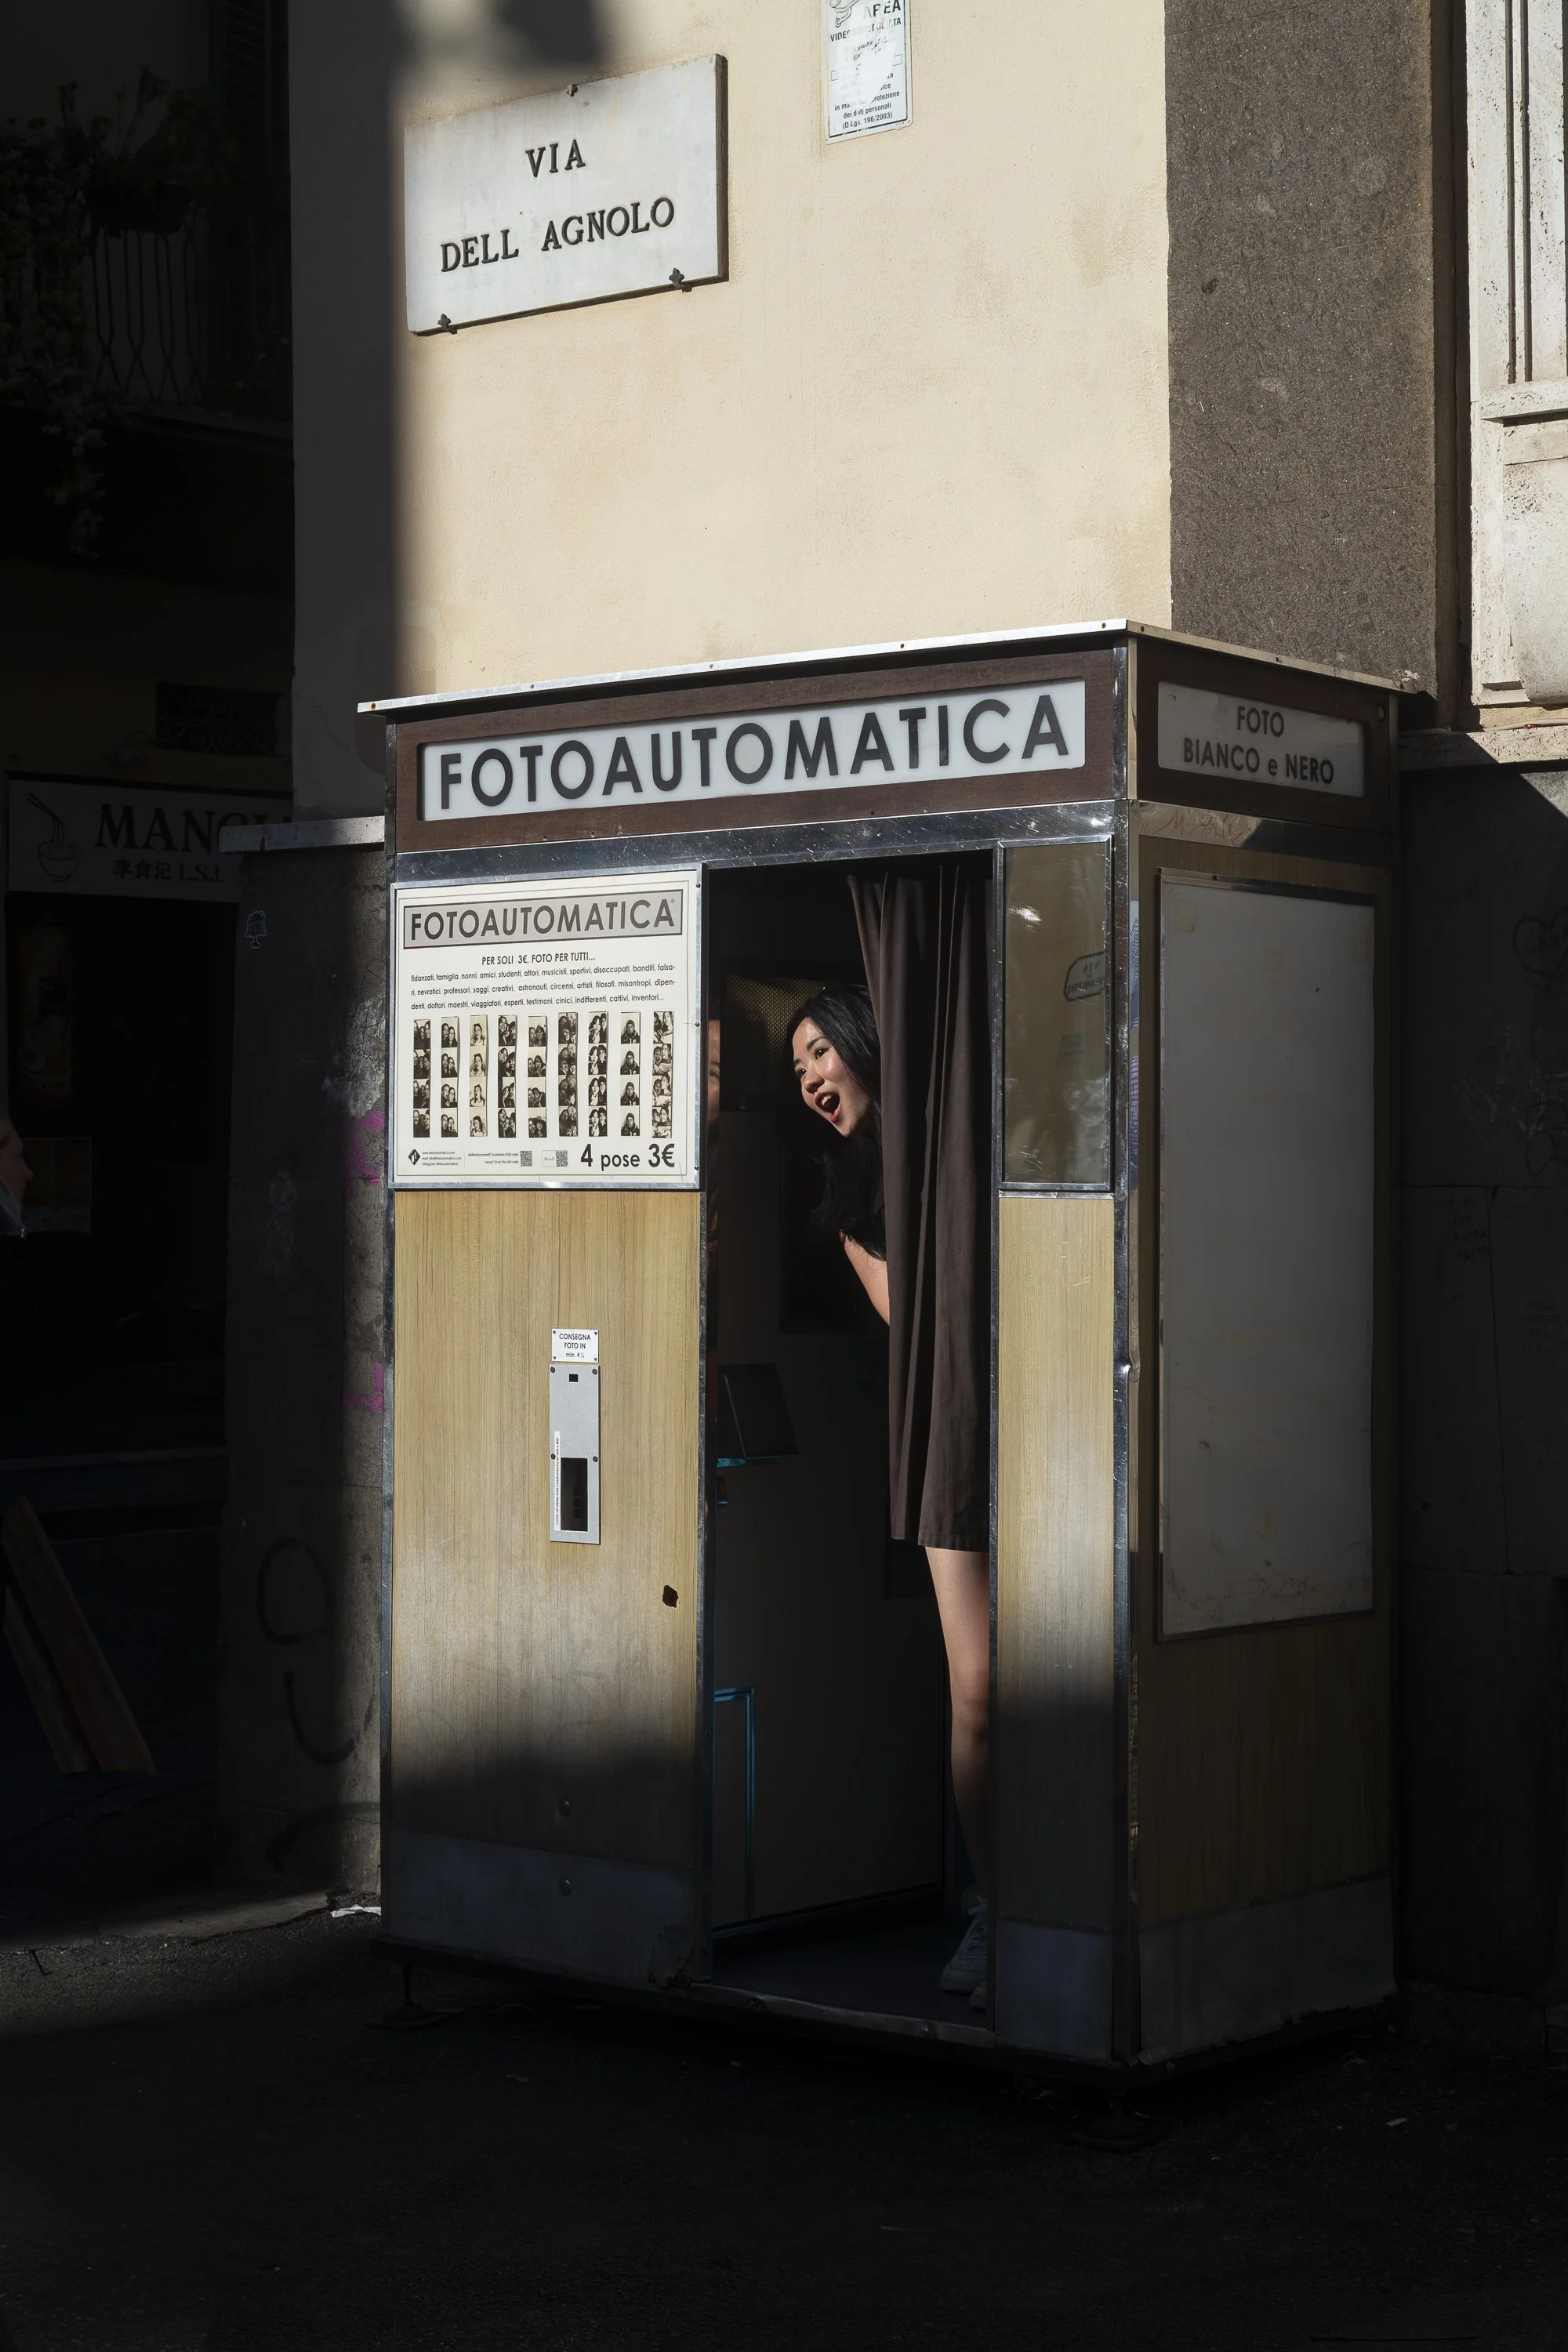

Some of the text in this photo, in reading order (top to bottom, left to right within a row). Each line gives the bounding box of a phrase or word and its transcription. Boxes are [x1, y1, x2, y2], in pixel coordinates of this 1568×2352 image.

[866, 102, 891, 115] personali
[524, 140, 586, 178] VIA
[440, 197, 674, 273] DELL AGNOLO
[1236, 706, 1285, 738] FOTO
[440, 694, 1069, 811] FOTOAUTOMATICA
[1183, 737, 1334, 785] BIANCO e NERO
[411, 898, 675, 941] FOTOAUTOMATICA
[436, 973, 460, 982] famiglia,
[499, 970, 523, 978] studenti,
[541, 967, 568, 976] musicisti,
[569, 967, 593, 976] sportivi,
[593, 965, 632, 974] disoccupati,
[657, 963, 676, 971] falsa-
[481, 952, 596, 966] PER SOLI 3€, FOTO PER TUTTI...
[444, 986, 472, 996] professori,
[518, 982, 549, 991] astronauti,
[550, 982, 575, 990] circensi,
[595, 980, 617, 989] filosofi,
[618, 979, 652, 988] misantropi,
[654, 978, 676, 987] dipen-
[470, 1000, 503, 1009] viaggiatori,
[503, 998, 525, 1007] esperti,
[555, 996, 574, 1005] cinici,
[610, 994, 630, 1003] cattivi,
[631, 993, 665, 1001] inventori...
[580, 1143, 675, 1171] 4 pose 3€
